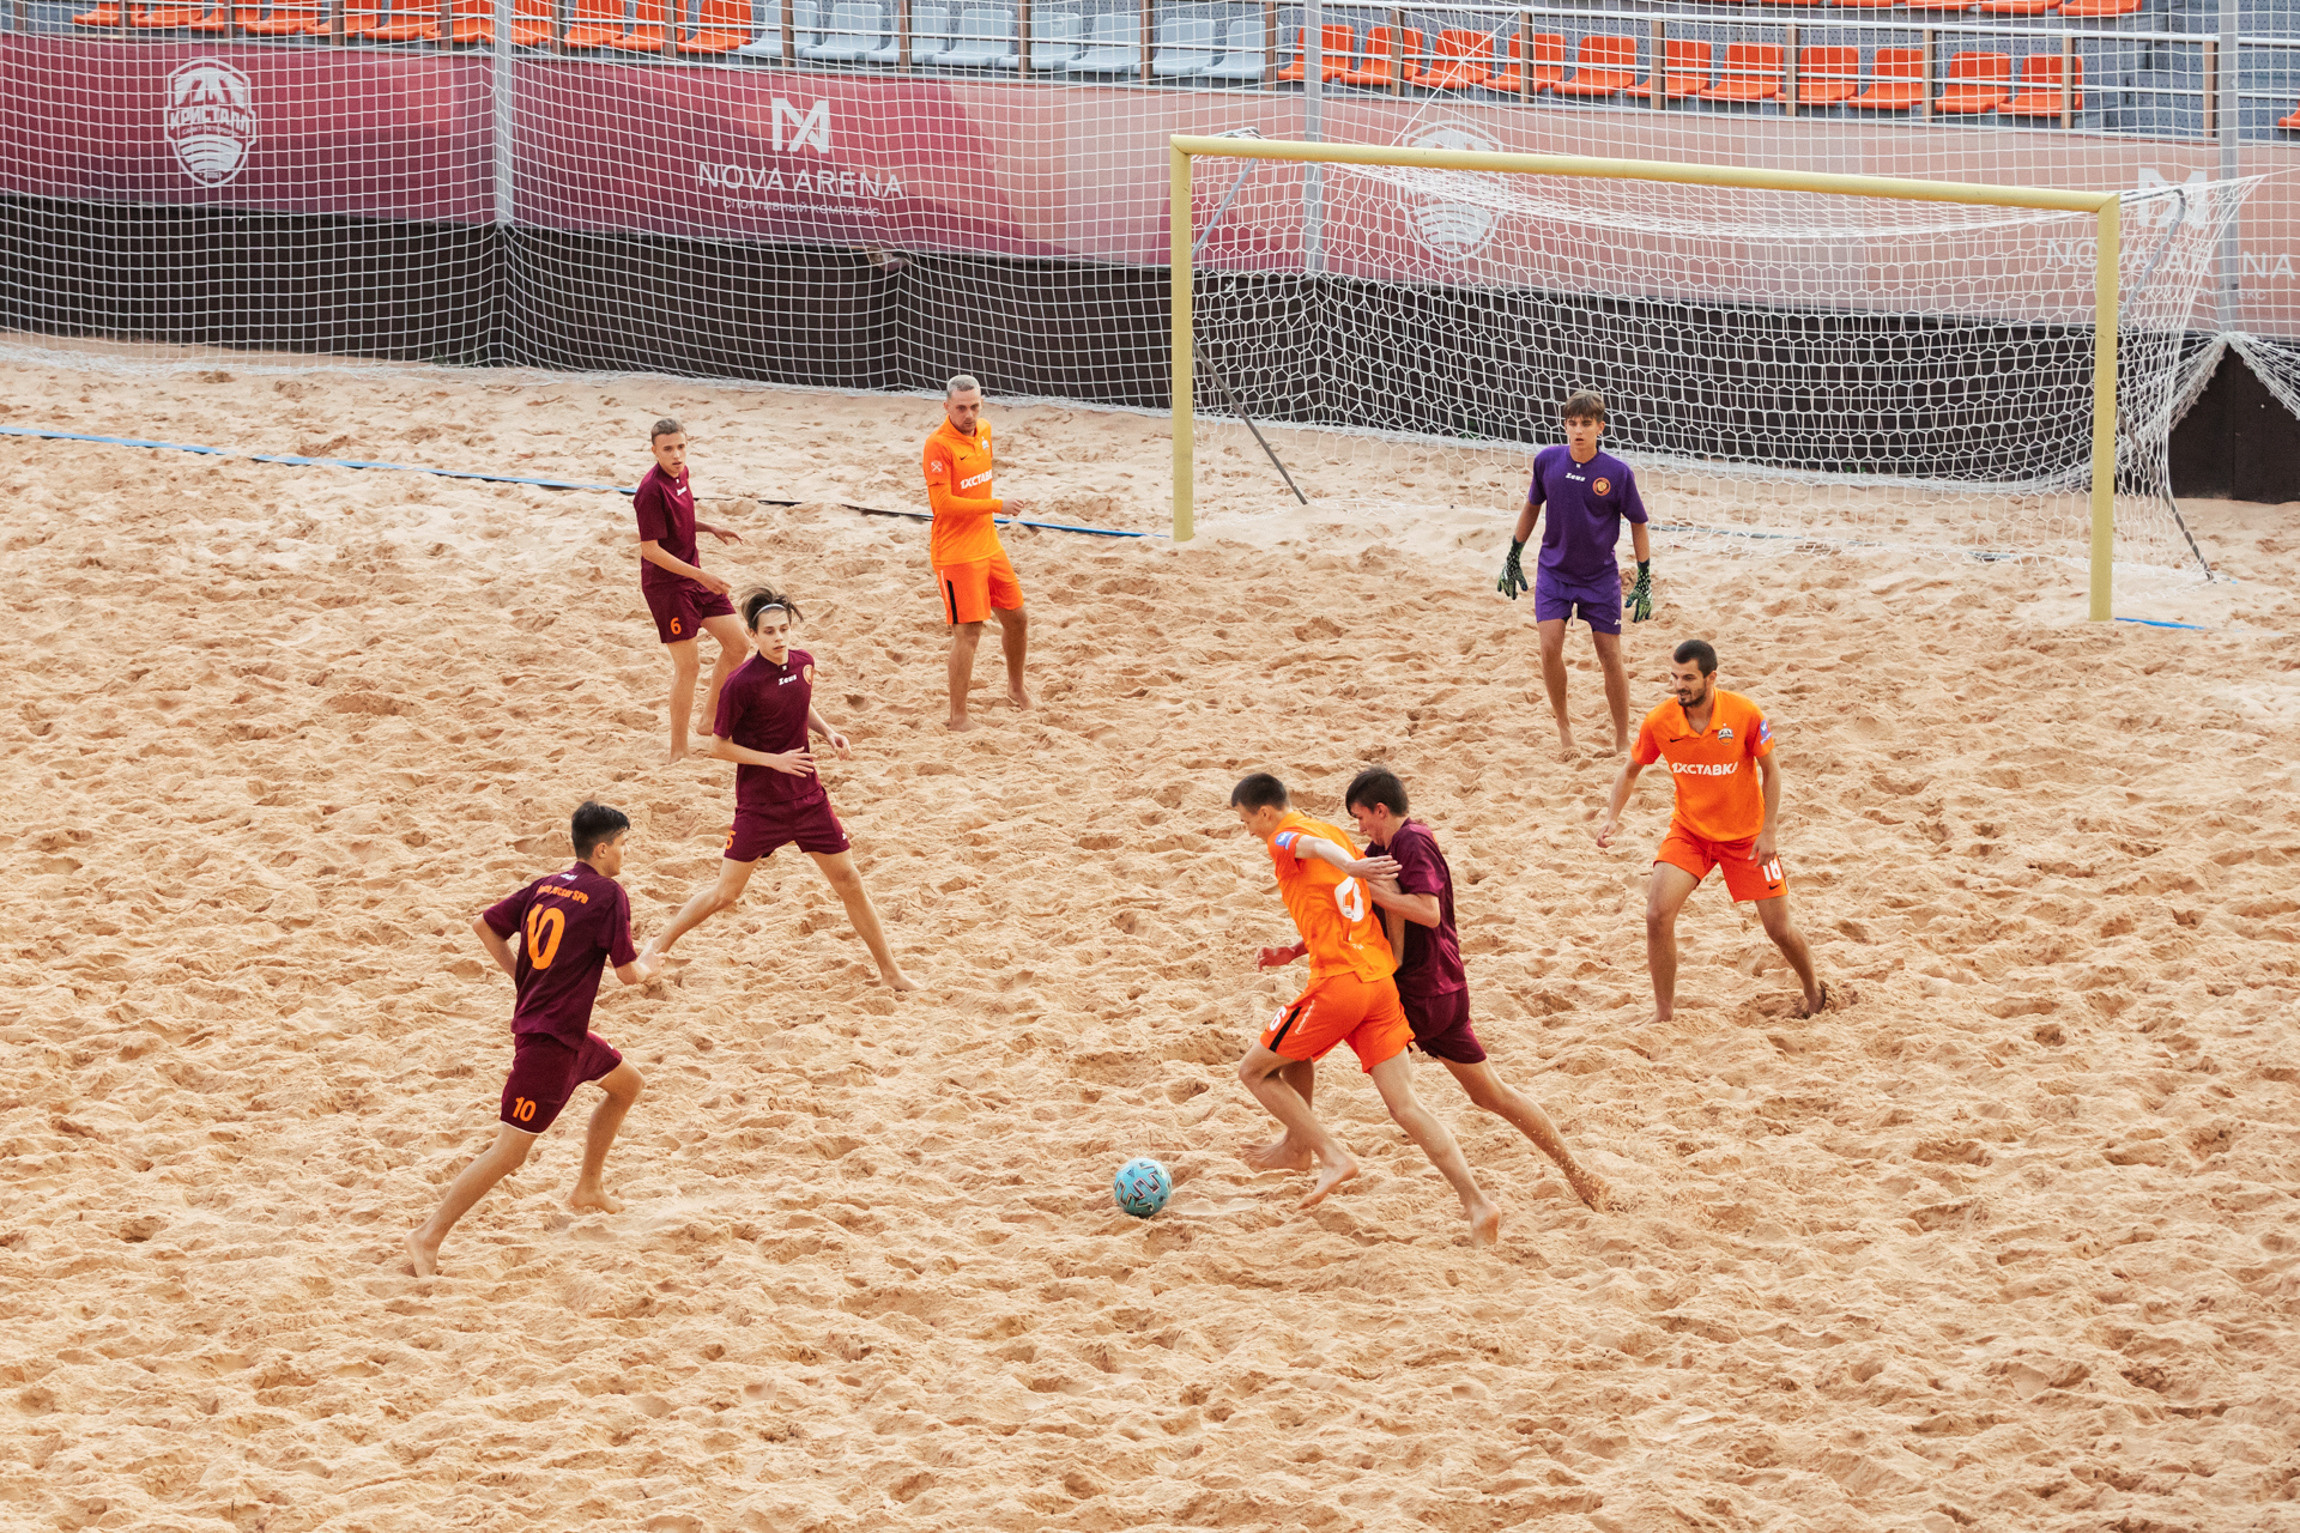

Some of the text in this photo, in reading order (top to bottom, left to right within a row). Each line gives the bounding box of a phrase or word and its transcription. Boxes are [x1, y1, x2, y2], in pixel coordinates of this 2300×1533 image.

[170, 106, 250, 134] КРИСТАЛЛ
[699, 163, 905, 199] NOVA ARENA
[723, 199, 880, 218] СПОРТИВНЫЙ КОМПЛЕКС
[2046, 239, 2151, 270] NOA
[671, 617, 682, 635] 6
[527, 904, 565, 970] 10
[1270, 1005, 1287, 1031] 6
[512, 1096, 537, 1122] 10
